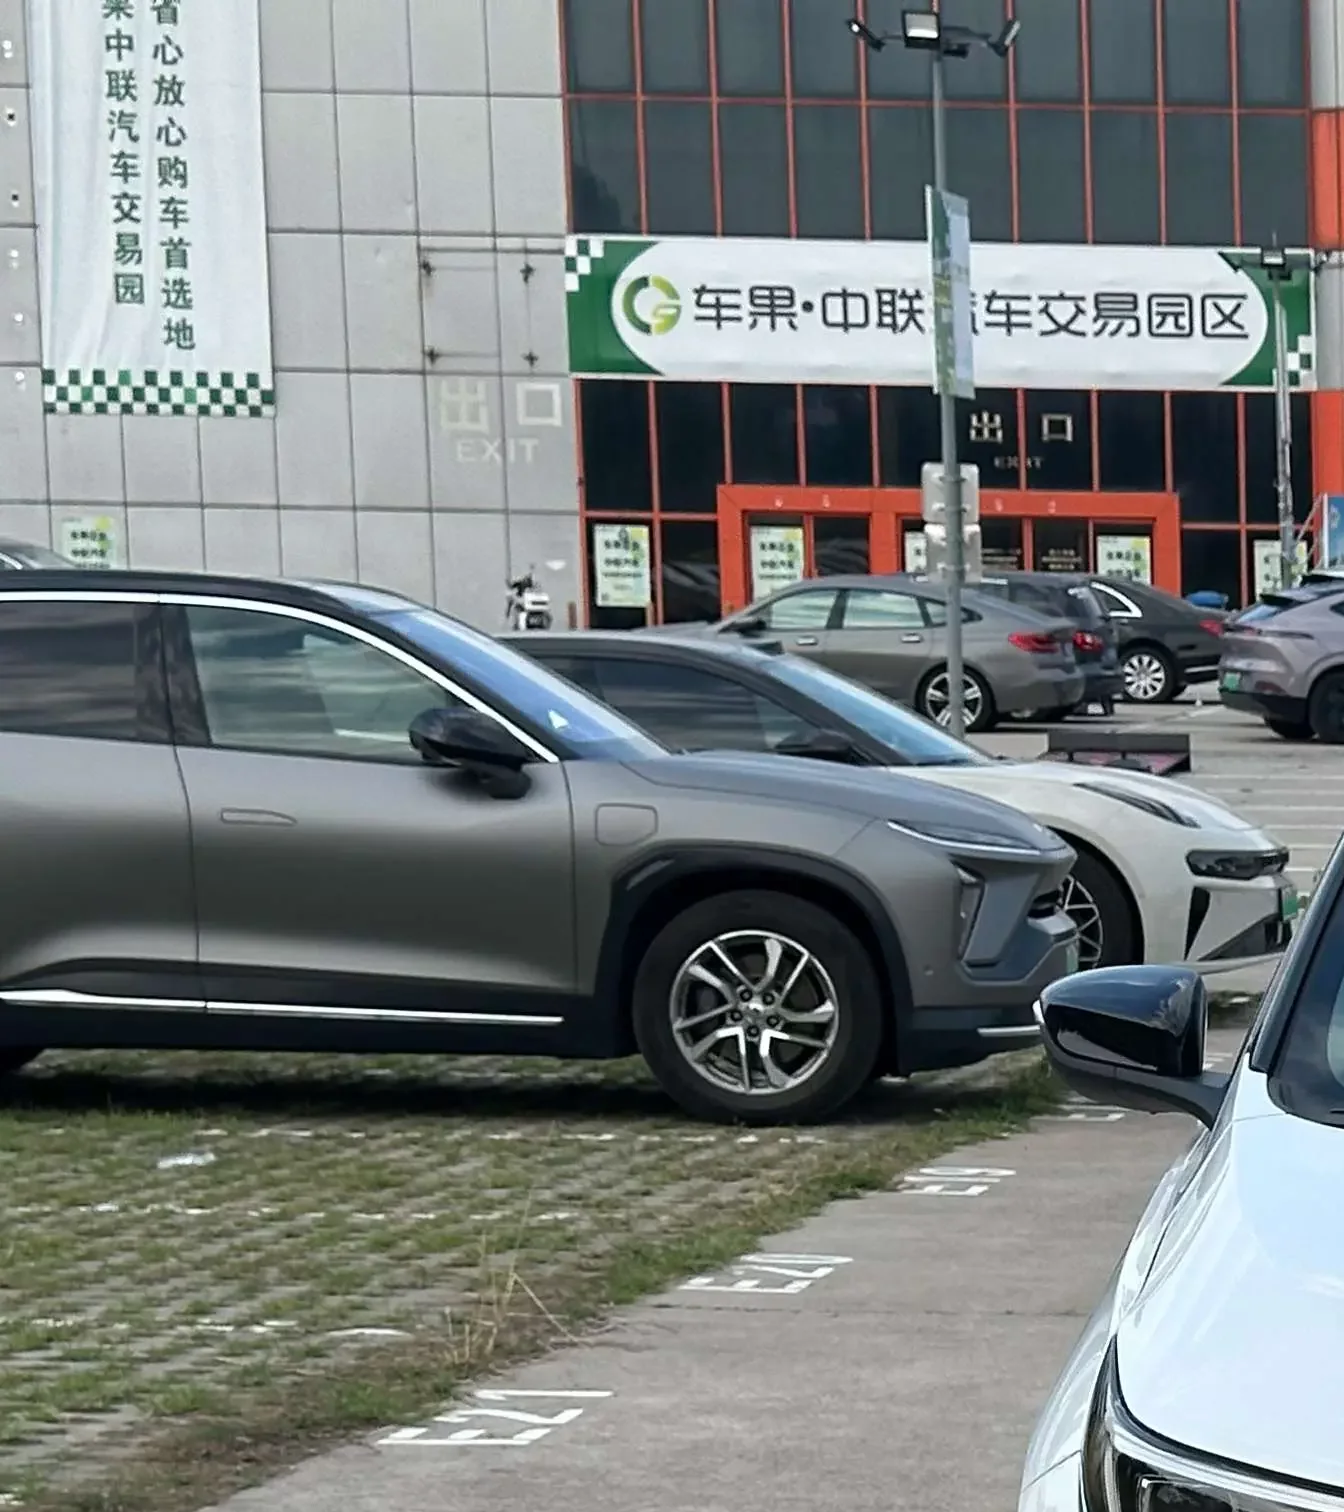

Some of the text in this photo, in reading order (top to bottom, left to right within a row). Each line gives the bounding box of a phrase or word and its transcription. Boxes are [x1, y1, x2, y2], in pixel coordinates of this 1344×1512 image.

[969, 410, 1074, 443] 出口
[455, 438, 540, 466] EXIT
[376, 1389, 613, 1446] E21
